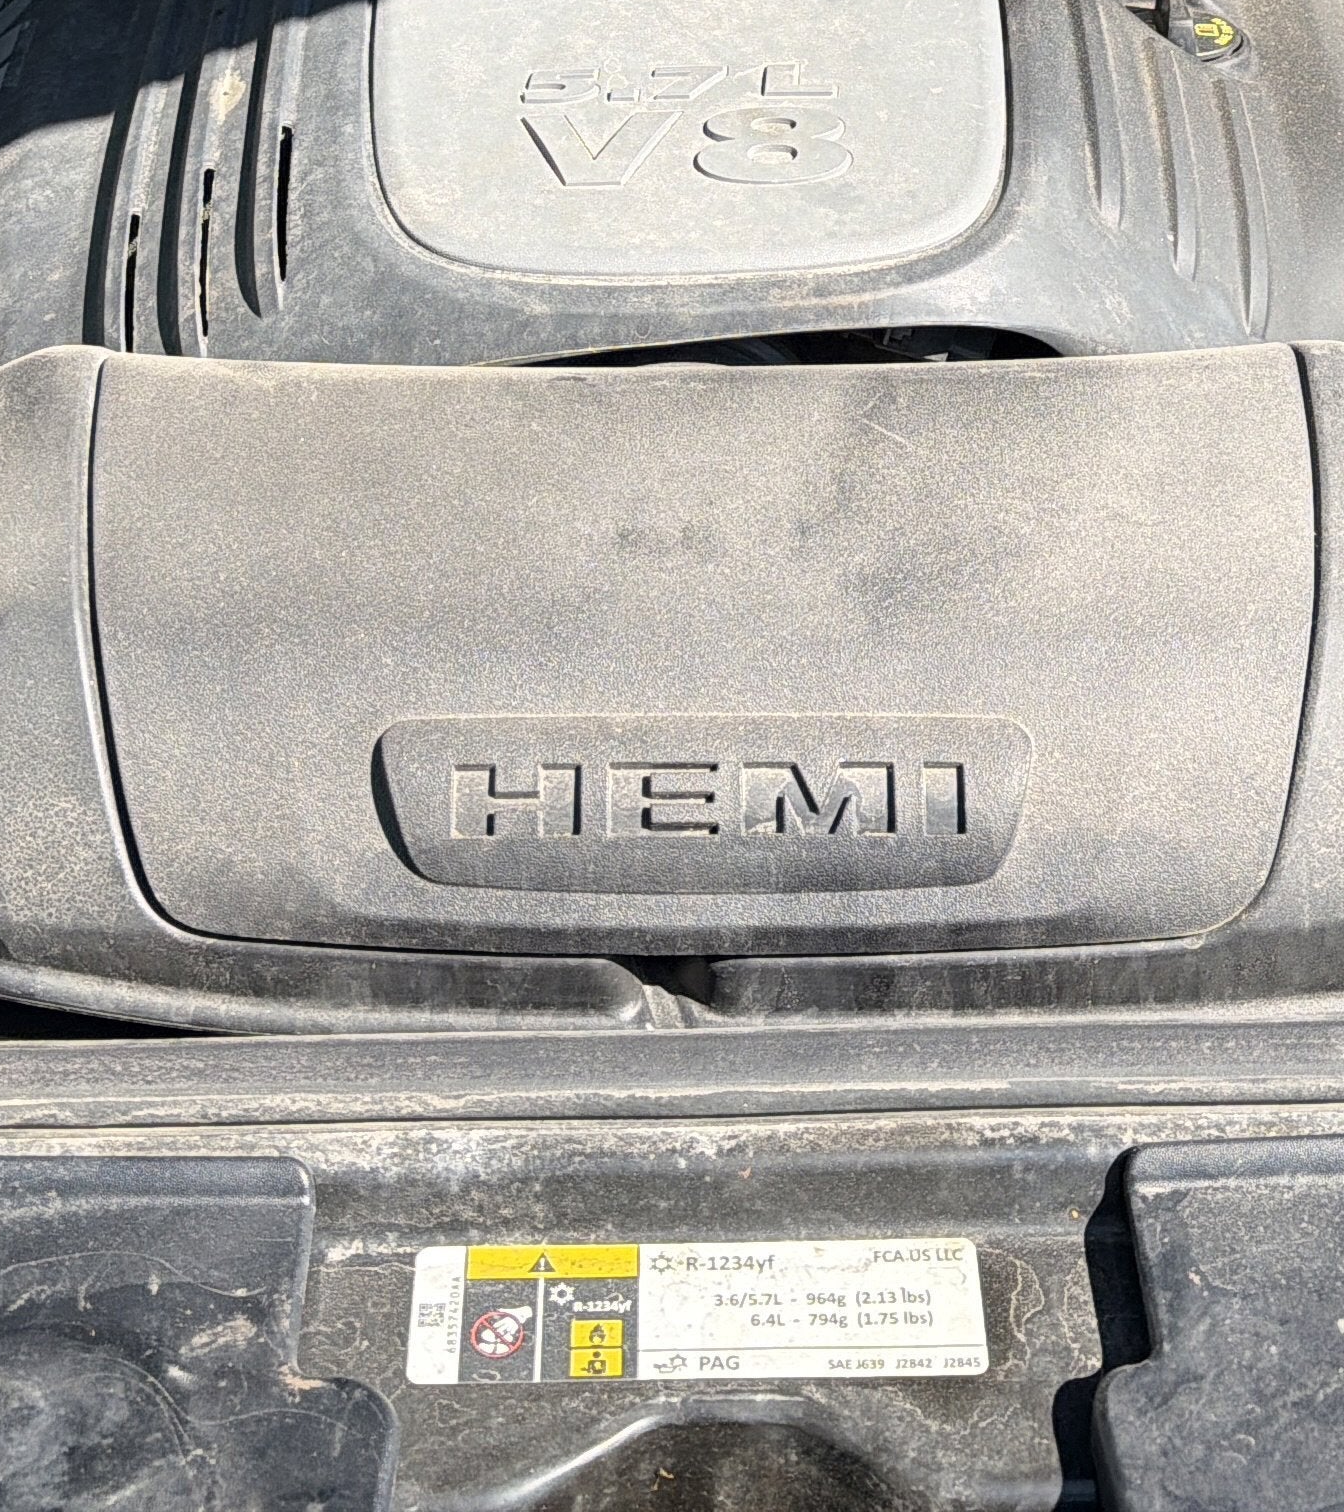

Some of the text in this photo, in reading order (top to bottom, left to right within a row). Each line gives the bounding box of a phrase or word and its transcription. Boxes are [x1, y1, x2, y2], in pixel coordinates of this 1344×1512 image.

[520, 107, 854, 187] V8
[451, 761, 967, 837] HEMI
[685, 1255, 776, 1273] R-1234yf
[873, 1247, 964, 1263] FCA US LLC
[573, 1299, 632, 1314] R-1234yf
[714, 1292, 784, 1308] 3.6/5.7L
[806, 1292, 847, 1307] 964g
[856, 1290, 897, 1307] (2.13
[900, 1287, 931, 1306] lbs)
[750, 1313, 785, 1327] 6.4L
[808, 1312, 848, 1328] 794g
[857, 1311, 899, 1328] (1.75
[903, 1310, 934, 1327] lbs)
[698, 1355, 741, 1371] PAG
[828, 1359, 852, 1370] SAE
[895, 1358, 933, 1370] J2842
[943, 1357, 981, 1369] J2845
